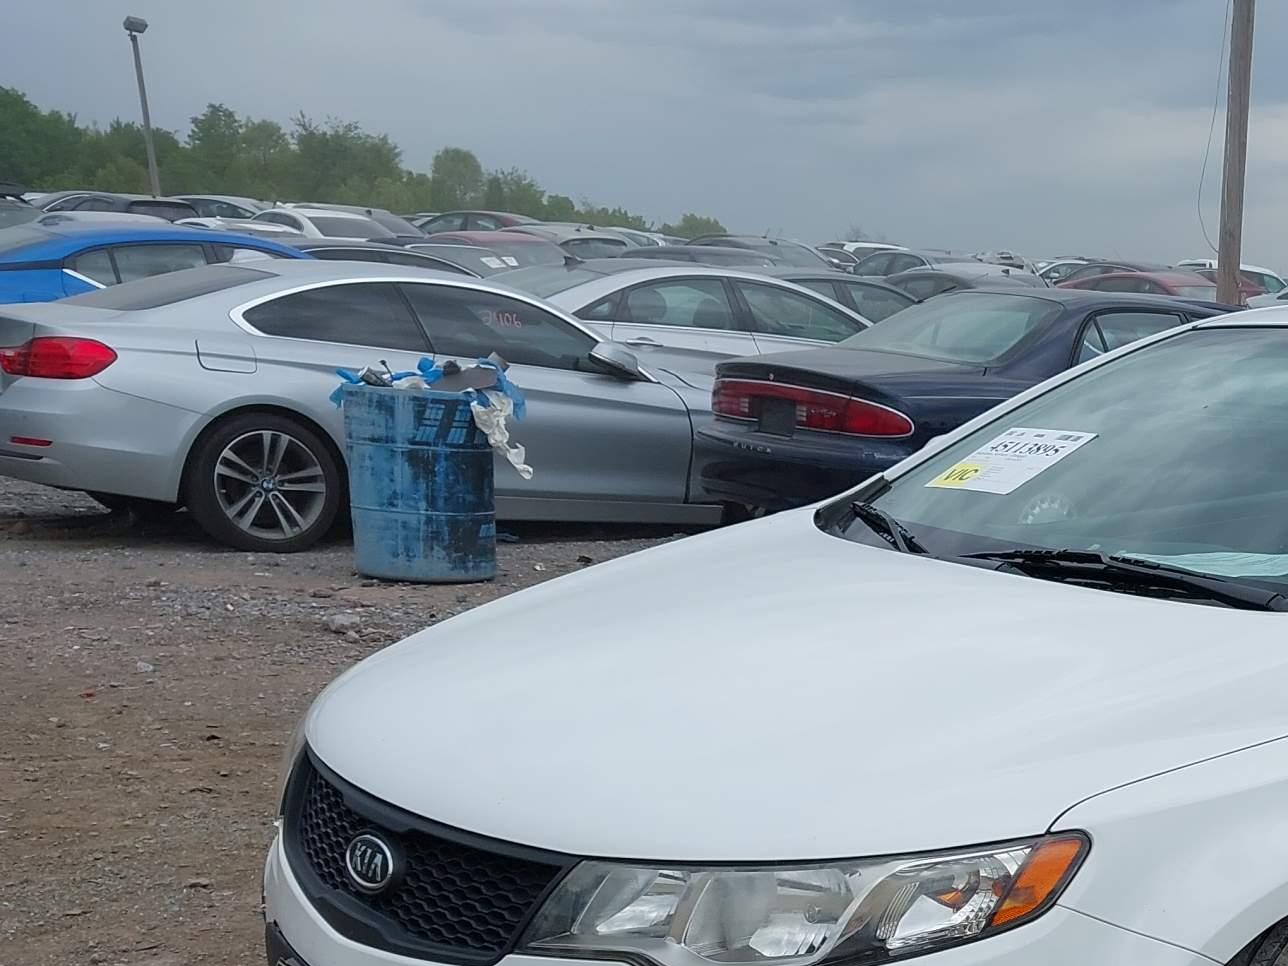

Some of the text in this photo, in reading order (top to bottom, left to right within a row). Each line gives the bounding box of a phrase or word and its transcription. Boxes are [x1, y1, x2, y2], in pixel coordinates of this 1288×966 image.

[989, 440, 1067, 458] 45113895
[943, 467, 979, 482] VIC
[352, 842, 383, 882] KIA
